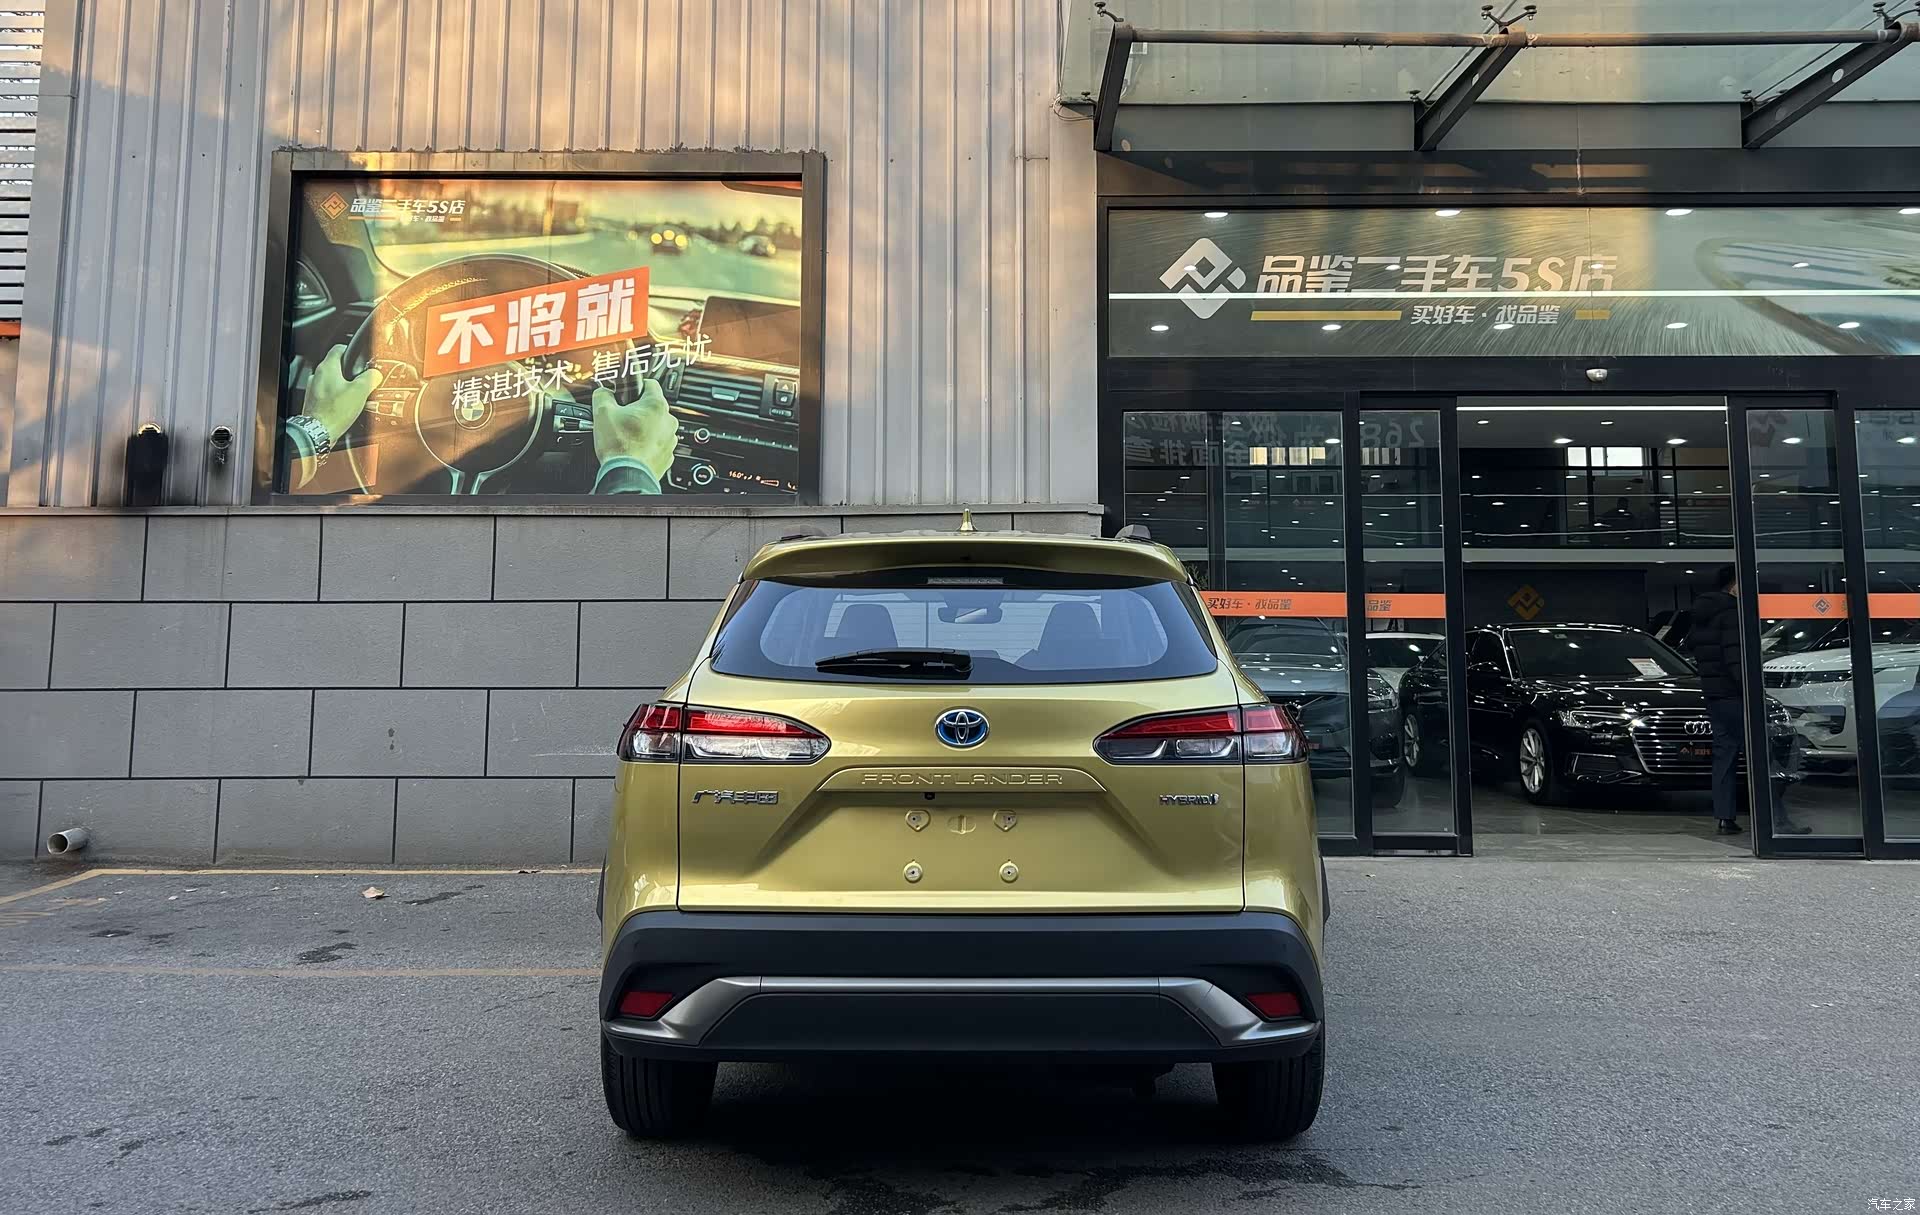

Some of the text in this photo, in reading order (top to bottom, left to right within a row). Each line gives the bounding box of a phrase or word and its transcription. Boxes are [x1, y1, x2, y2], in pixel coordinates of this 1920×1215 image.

[350, 198, 466, 215] 品鉴二手车5S店
[1256, 253, 1619, 293] 品鉴二手车5S店
[437, 277, 636, 365] 不将就
[451, 332, 714, 411] 精湛技术 售后无忧
[861, 773, 1064, 785] FRONTLANDER
[692, 789, 778, 804] 广汽丰田
[1159, 794, 1211, 806] HYBRID
